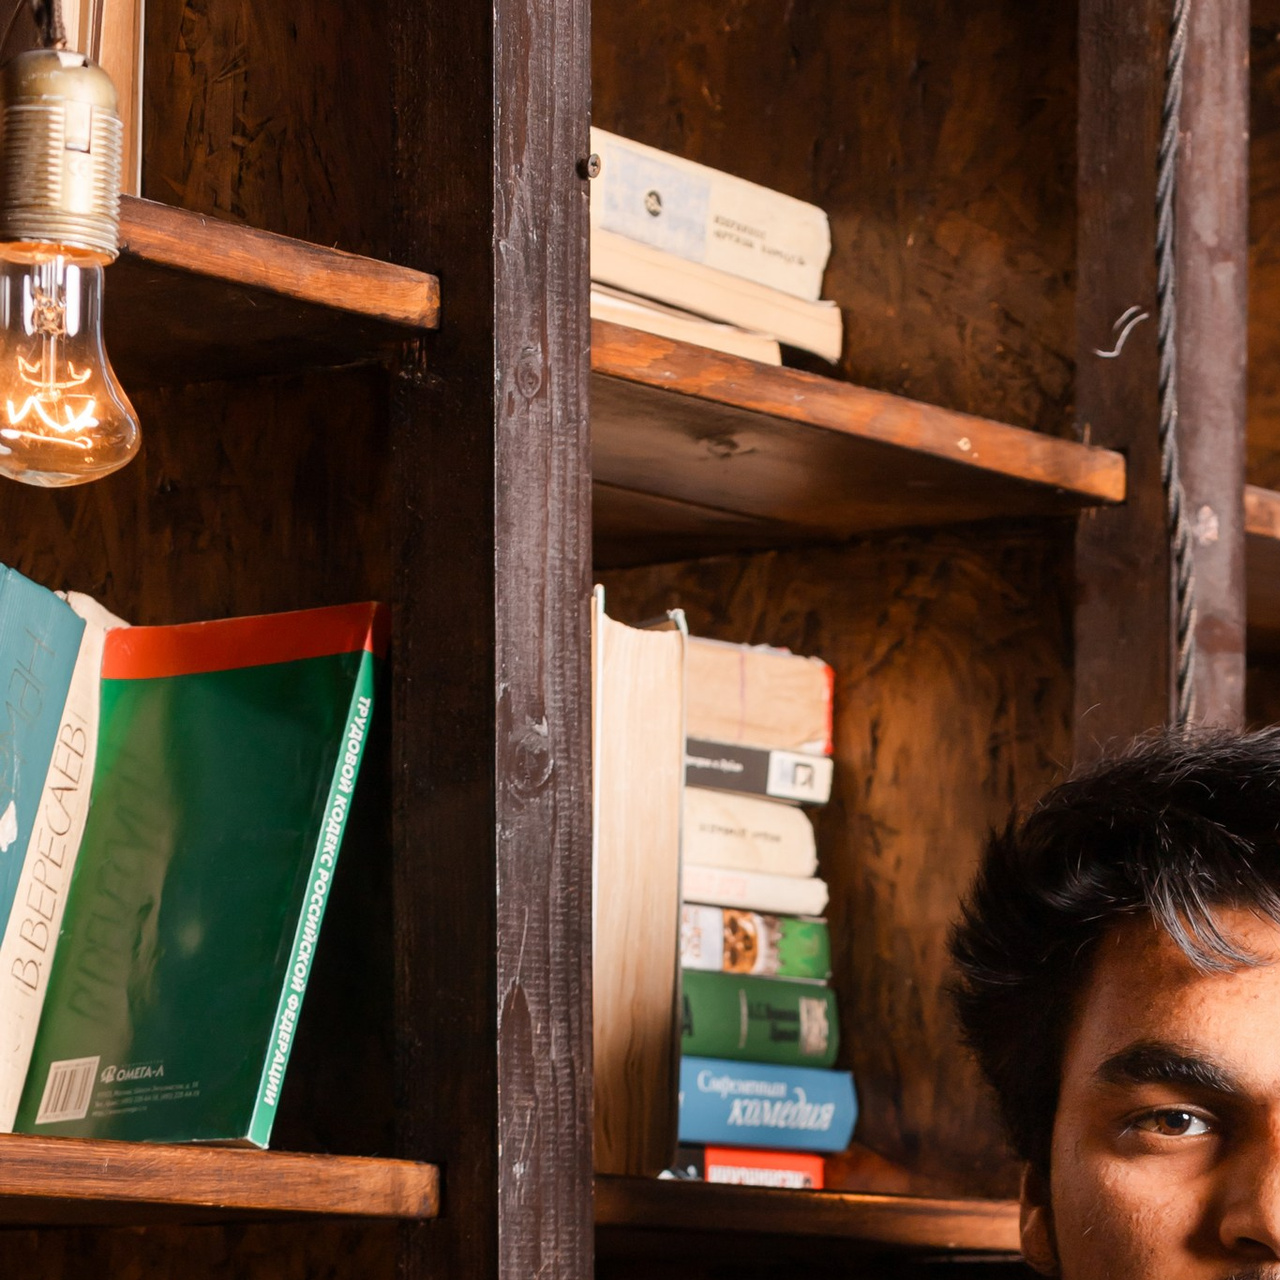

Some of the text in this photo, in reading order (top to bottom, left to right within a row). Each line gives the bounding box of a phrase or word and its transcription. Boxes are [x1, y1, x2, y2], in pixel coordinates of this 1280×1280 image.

[263, 696, 371, 1107] ТРУДОВОЙ КОДЕКС РОССИЙСКОЙ ФЕДЕРАЦИИ
